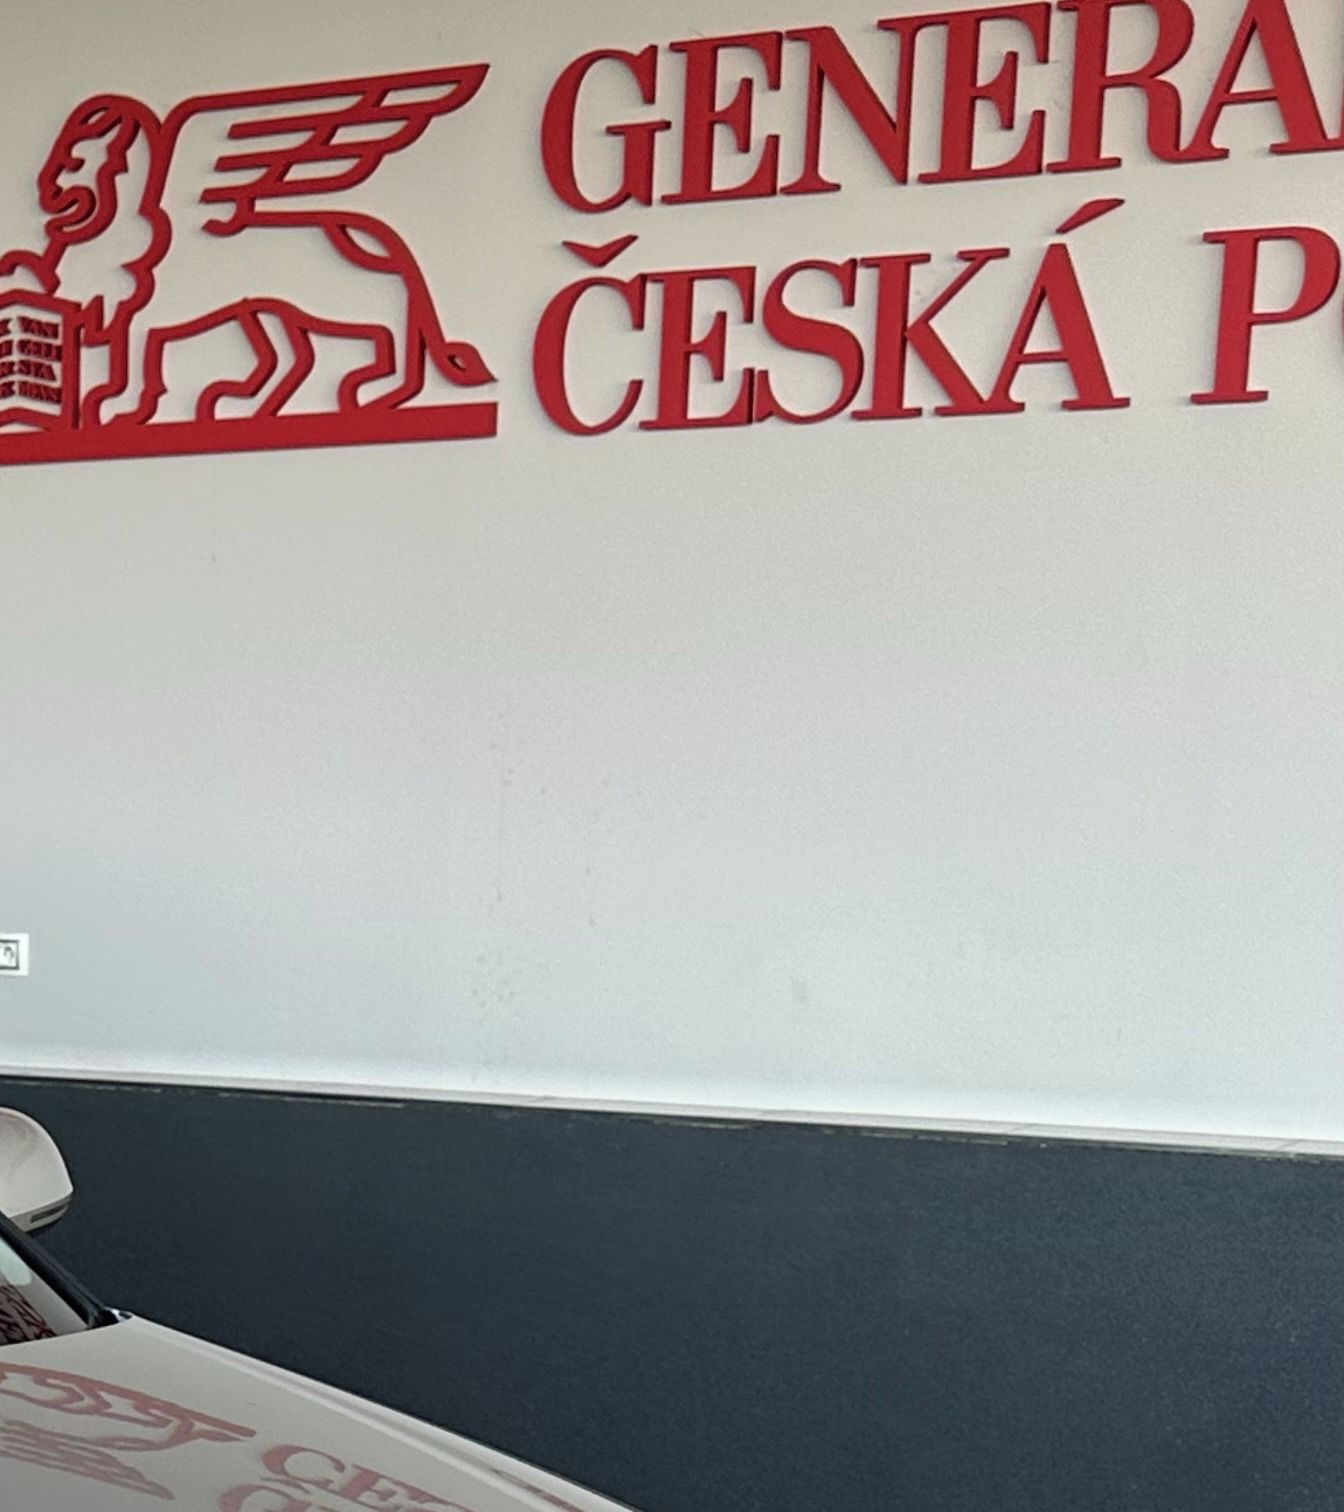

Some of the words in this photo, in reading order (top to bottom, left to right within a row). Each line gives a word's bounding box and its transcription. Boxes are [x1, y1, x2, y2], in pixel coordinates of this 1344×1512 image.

[540, 0, 1344, 214] GENERA
[532, 198, 1131, 437] ČESKÁ
[1190, 226, 1344, 406] P
